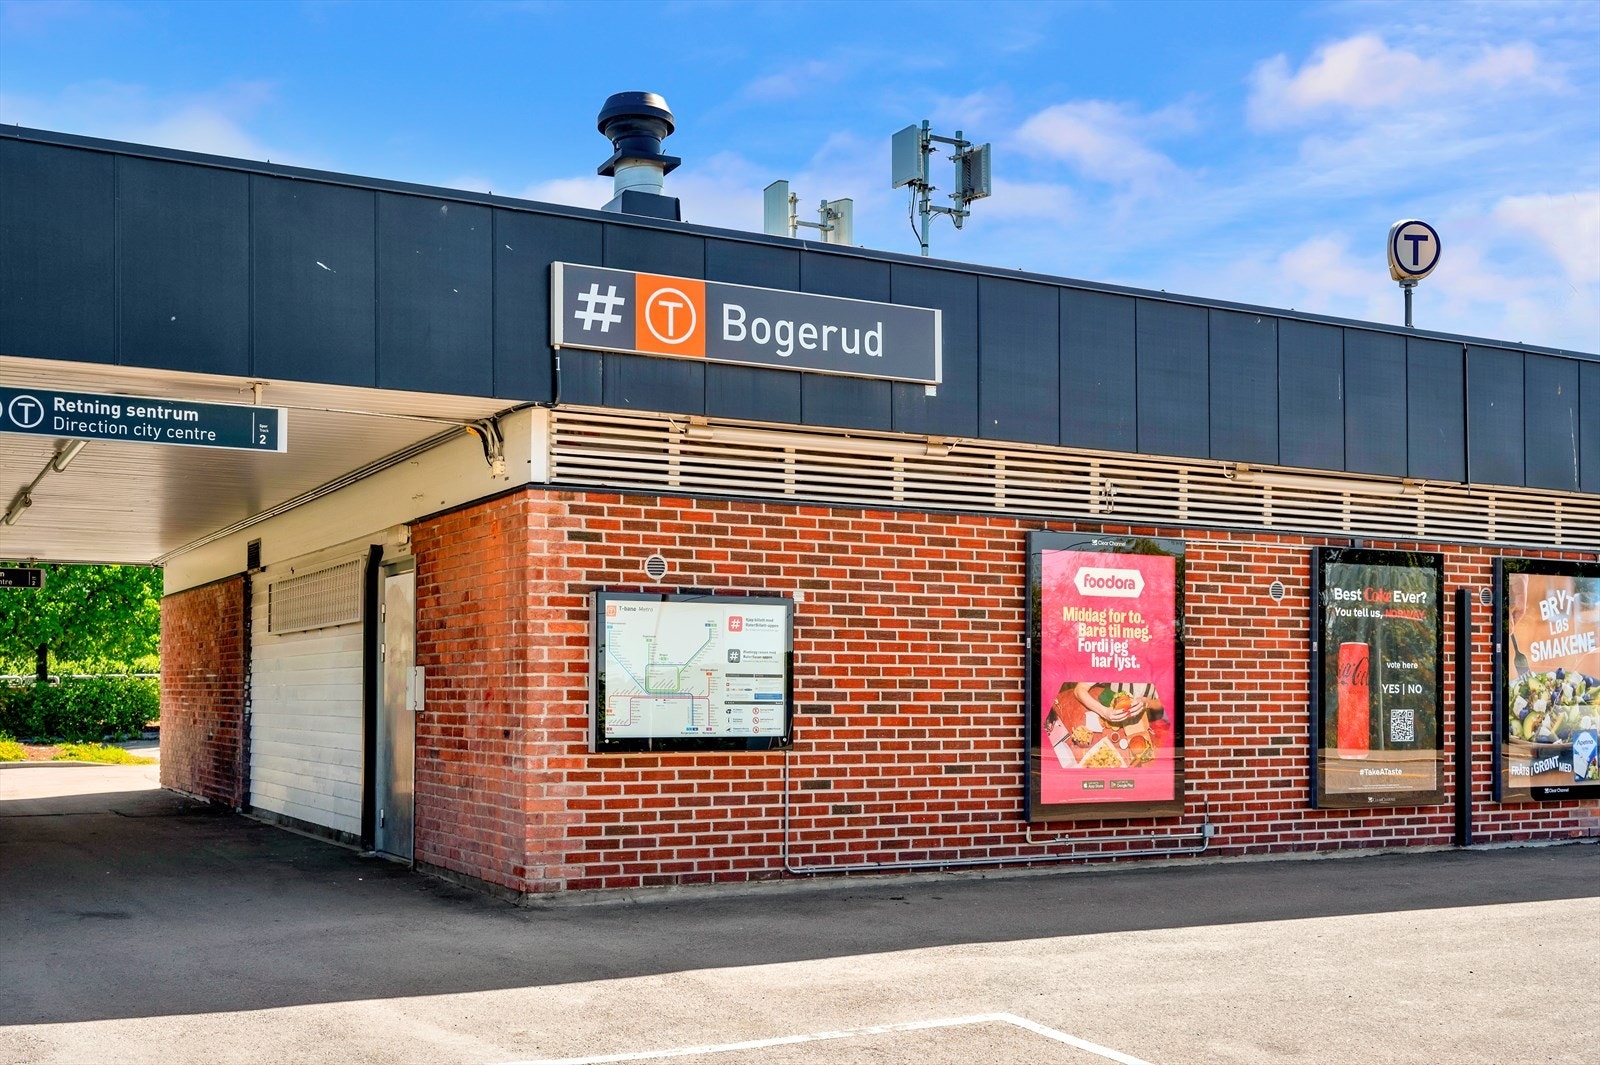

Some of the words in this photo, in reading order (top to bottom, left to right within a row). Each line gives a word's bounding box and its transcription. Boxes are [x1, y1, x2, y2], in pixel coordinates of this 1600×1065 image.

[722, 303, 883, 357] Bogerud
[53, 397, 120, 419] Retning
[127, 406, 199, 421] sentrum
[53, 416, 128, 434] Direction
[133, 423, 161, 440] city
[167, 427, 216, 441] centre
[259, 434, 267, 444] 2
[1083, 573, 1135, 590] foodora
[1334, 587, 1362, 601] Best
[1363, 587, 1392, 603] Coke
[1393, 590, 1427, 604] Ever?
[1334, 607, 1351, 617] You
[1353, 608, 1369, 617] tell
[1370, 609, 1383, 619] us,
[1539, 590, 1575, 621] BRYT
[1063, 606, 1107, 626] Middag
[1108, 608, 1127, 624] for
[1128, 610, 1145, 624] to.
[1078, 622, 1107, 638] Bare
[1108, 624, 1120, 638] til
[1122, 625, 1153, 642] meg.
[1549, 617, 1570, 635] LØS
[1078, 637, 1109, 653] Fordi
[1109, 638, 1129, 657] jeg
[1530, 631, 1596, 662] SMAKENE
[1091, 653, 1113, 668] har
[1114, 653, 1140, 672] lyst.
[1386, 661, 1400, 669] vote
[1402, 661, 1418, 669] here
[1382, 683, 1400, 694] YES
[1408, 684, 1423, 694] NO
[1359, 768, 1402, 776] #TakeATaste
[1511, 763, 1530, 776] FRÅTS
[1533, 755, 1560, 774] GRØNT
[1559, 762, 1572, 773] MED
